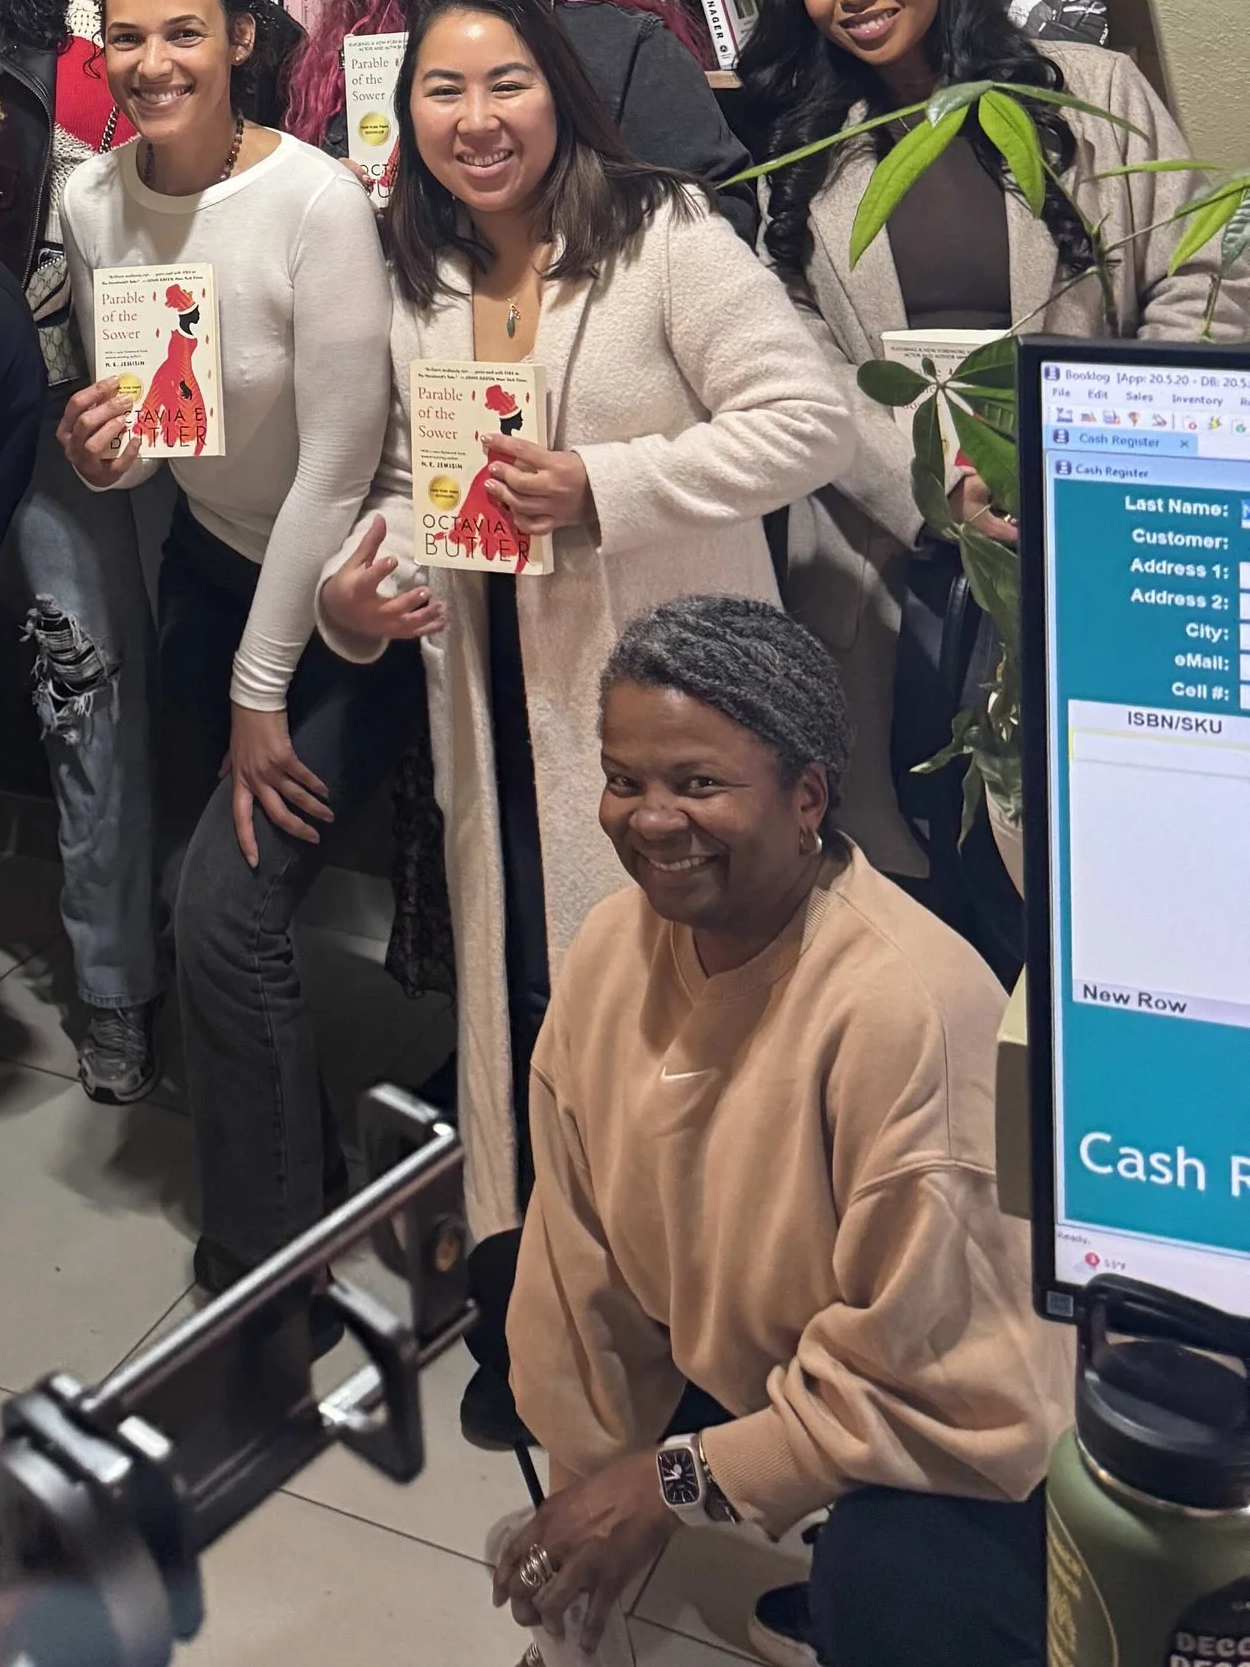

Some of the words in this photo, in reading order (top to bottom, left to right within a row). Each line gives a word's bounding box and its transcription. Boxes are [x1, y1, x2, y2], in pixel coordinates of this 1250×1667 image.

[351, 58, 389, 70] Parable
[352, 75, 364, 86] of
[366, 73, 383, 85] the
[352, 90, 385, 102] Sower
[102, 291, 145, 305] Parable
[102, 310, 116, 323] of
[119, 310, 137, 322] the
[102, 328, 141, 341] Sower
[1066, 370, 1110, 382] Booklog
[1150, 375, 1189, 385] 20.5.20
[1224, 378, 1250, 388] 20.5.
[418, 387, 463, 401] Parable
[1052, 387, 1071, 397] File
[1088, 390, 1108, 400] Edit
[1126, 392, 1153, 402] Sales
[1172, 394, 1223, 407] Inventory
[418, 407, 433, 419] of
[435, 406, 455, 420] the
[418, 425, 458, 440] Sower
[1079, 434, 1108, 445] Cash
[1112, 436, 1160, 448] Register
[1076, 464, 1102, 475] Cash
[1106, 466, 1149, 478] Register
[1125, 495, 1163, 512] Last
[1168, 499, 1229, 517] Name:
[422, 513, 506, 534] OCTAVIA
[424, 533, 530, 562] BUTLER
[1132, 529, 1229, 549] Customer:
[1130, 557, 1207, 578] Address
[1212, 564, 1229, 579] 1:
[1130, 588, 1207, 608] Address
[1211, 594, 1229, 610] 2:
[1186, 623, 1229, 643] City:
[1174, 653, 1229, 671] eMail:
[1171, 682, 1207, 699] Cell
[1211, 686, 1229, 701] #:
[1127, 711, 1222, 734] ISBN/SKU
[1083, 984, 1130, 1006] New
[1137, 992, 1187, 1014] Row
[1079, 1132, 1205, 1191] Cash
